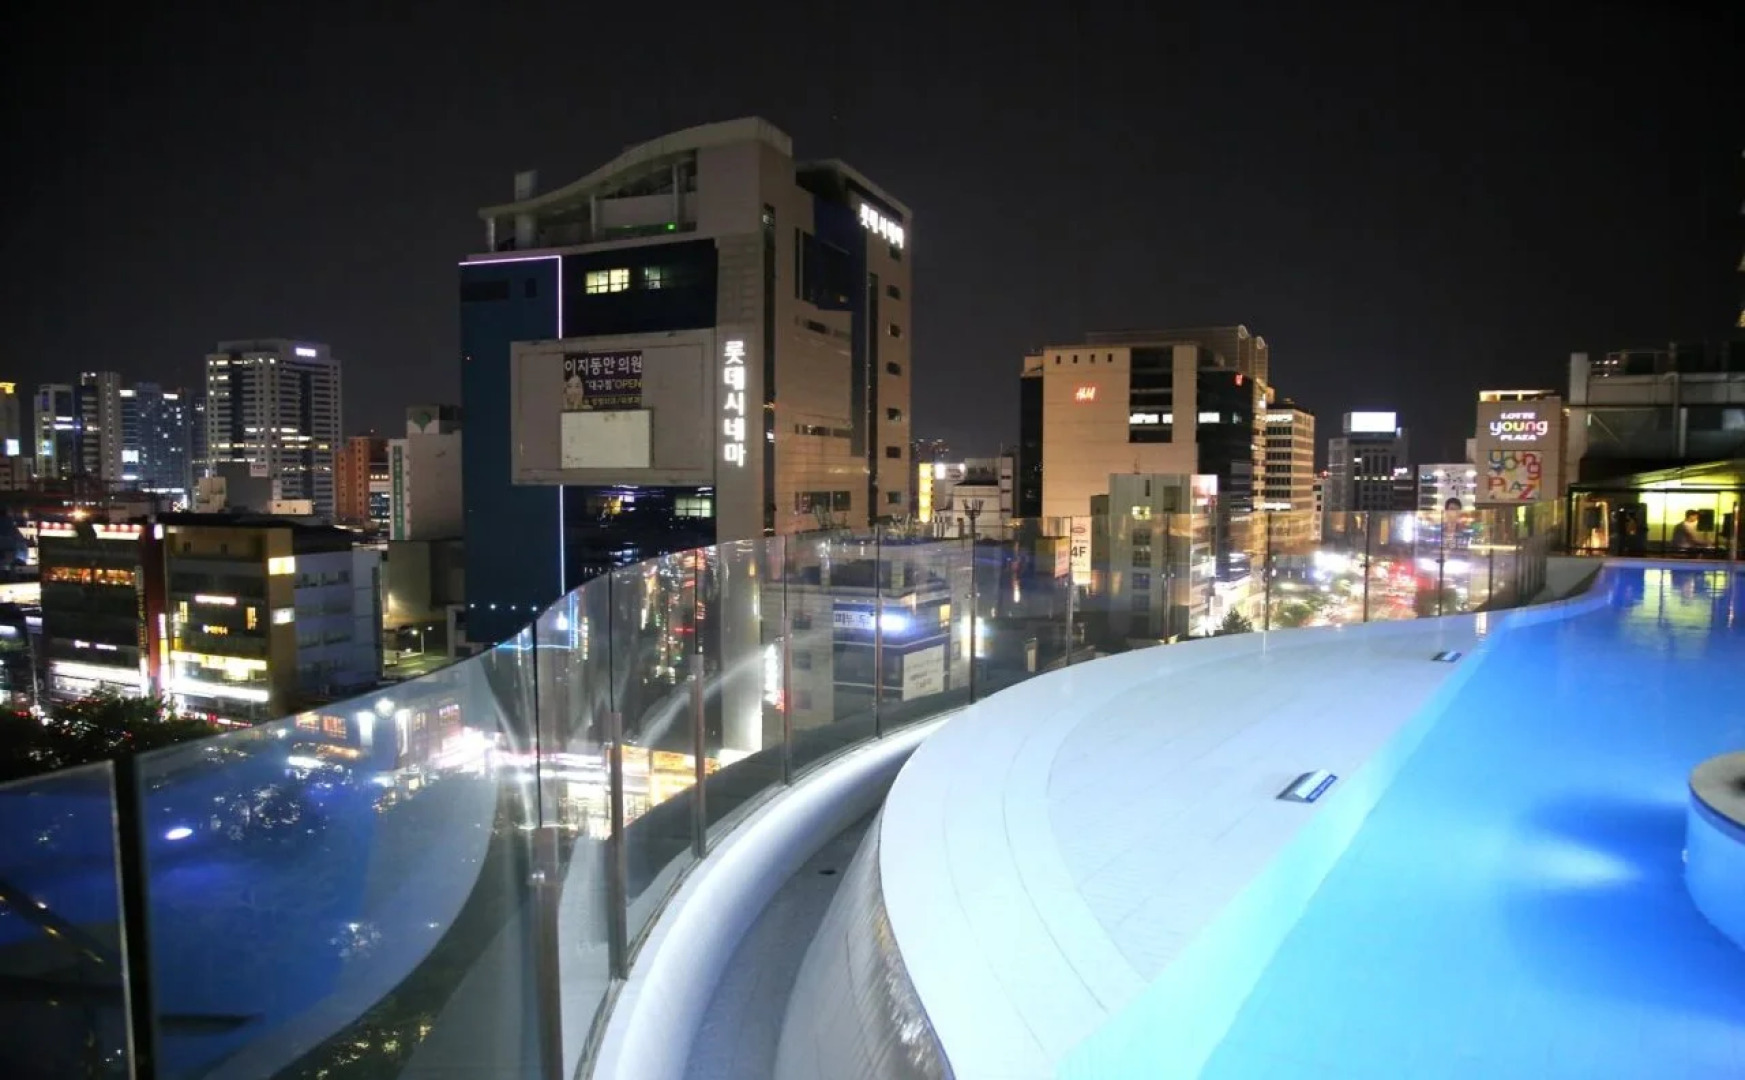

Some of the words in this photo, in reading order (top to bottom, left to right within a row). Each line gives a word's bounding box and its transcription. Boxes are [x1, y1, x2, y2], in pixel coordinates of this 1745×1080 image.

[723, 340, 747, 467] 롯데시네마
[1500, 412, 1536, 420] LOTTE
[1489, 419, 1548, 436] young
